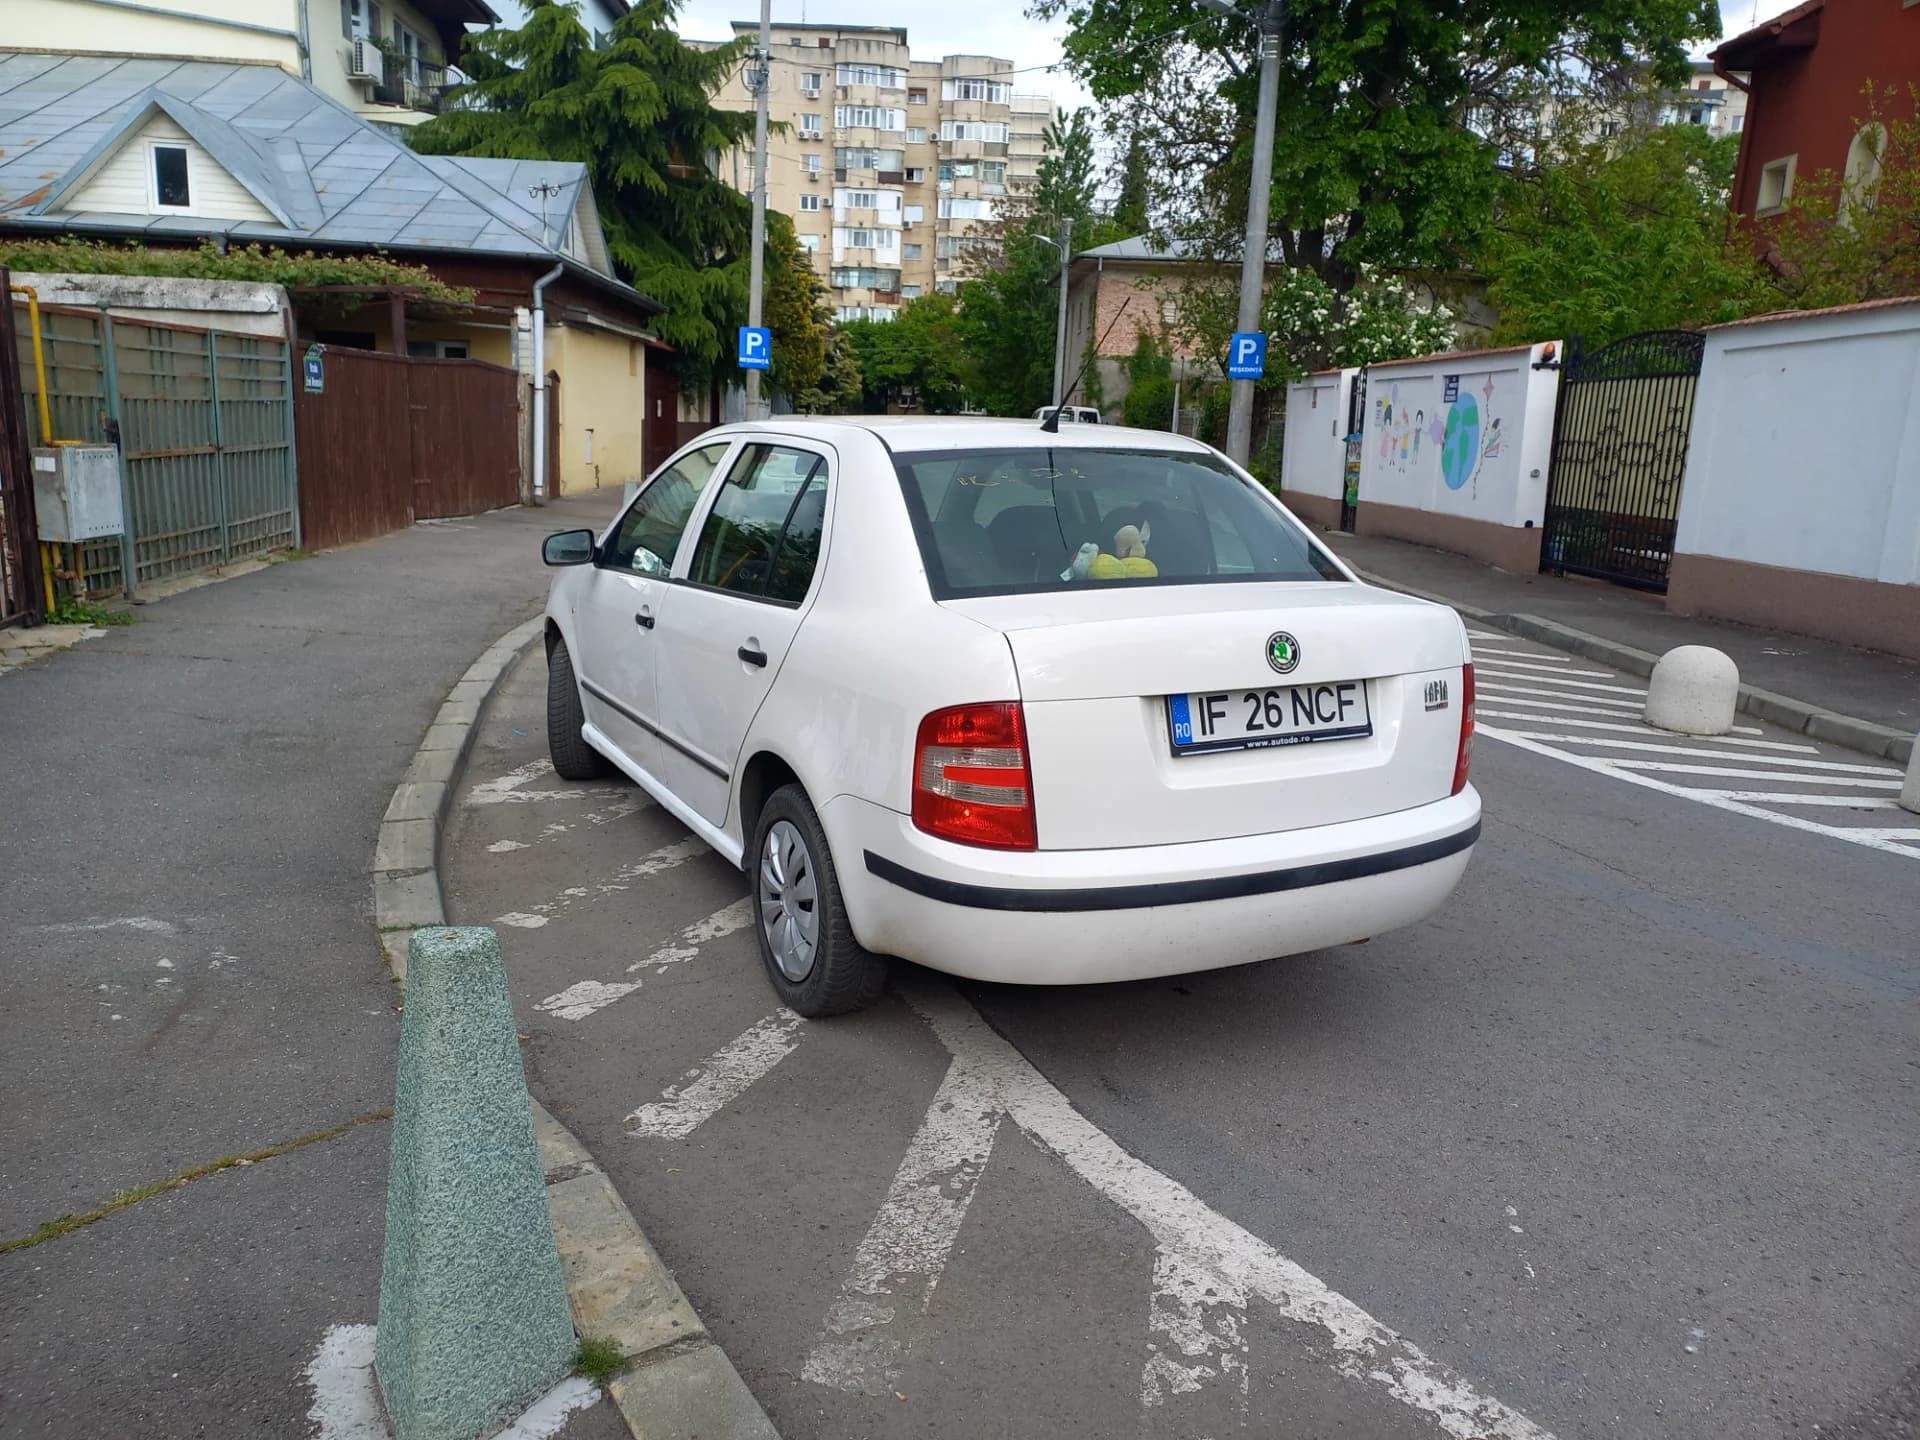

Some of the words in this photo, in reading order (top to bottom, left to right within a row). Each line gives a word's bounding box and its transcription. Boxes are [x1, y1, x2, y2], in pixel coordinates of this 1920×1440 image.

[747, 333, 763, 354] P
[1238, 339, 1257, 364] P
[1198, 694, 1228, 736] IF
[1243, 690, 1283, 731] 26
[1290, 683, 1356, 727] NCF
[1175, 722, 1190, 738] RO
